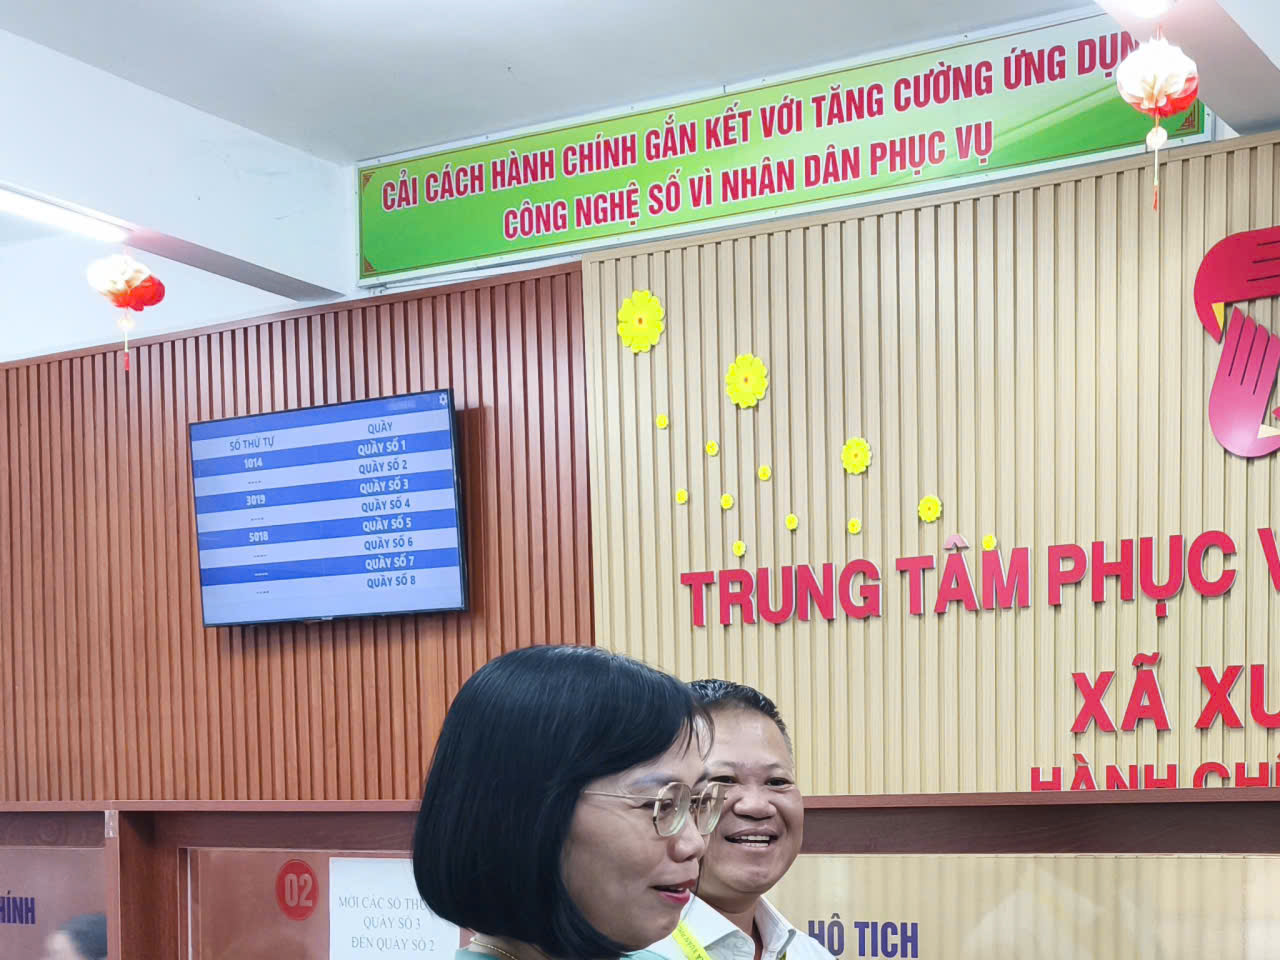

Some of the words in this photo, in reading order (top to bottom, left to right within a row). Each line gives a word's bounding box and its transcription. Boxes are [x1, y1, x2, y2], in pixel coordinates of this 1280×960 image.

[383, 169, 417, 210] CẢI
[426, 164, 483, 201] CÁCH
[492, 151, 553, 190] HÀNH
[563, 134, 636, 176] CHÍNH
[645, 115, 696, 160] GẮN
[706, 102, 752, 150] KẾT
[761, 94, 802, 138] VỚI
[812, 85, 883, 128] TĂNG
[894, 62, 992, 112] CƯỜNG
[1004, 46, 1065, 91] ỨNG
[504, 200, 567, 240] CÔNG
[576, 182, 639, 226] NGHỆ
[649, 168, 681, 215] SỐ
[690, 168, 712, 208] VÌ
[722, 155, 794, 203] NHÂN
[805, 144, 860, 188] DÂN
[871, 131, 945, 175] PHỤC
[956, 121, 993, 165] VỤ
[230, 436, 240, 451] SỐ
[368, 419, 393, 434] QUẦY
[244, 457, 263, 468] 1014
[358, 440, 384, 456] QUẦY
[386, 437, 399, 452] SỐ
[401, 440, 406, 450] 1
[359, 459, 385, 474] QUẦY
[387, 457, 400, 472] SỐ
[402, 460, 408, 470] 2
[360, 479, 386, 494] QUẦY
[388, 476, 401, 491] SỐ
[403, 479, 409, 489] 3
[362, 498, 387, 513] QUẦY
[390, 495, 402, 509] SỐ
[404, 498, 410, 508] 4
[249, 531, 269, 543] 5018
[362, 517, 389, 532] QUẦY
[391, 514, 404, 529] SỐ
[406, 518, 412, 528] 5
[364, 536, 390, 551] QUẦY
[393, 534, 405, 548] SỐ
[408, 537, 413, 547] 6
[365, 555, 392, 570] QUẦY
[394, 552, 407, 567] SỐ
[408, 555, 415, 566] 7
[367, 574, 393, 589] QUẦY
[395, 572, 408, 586] SỐ
[410, 575, 416, 585] 8
[680, 559, 882, 627] TRUNG
[896, 534, 1030, 615] TÂM
[1048, 530, 1237, 617] PHỤC
[1070, 651, 1171, 734] XÃ
[1031, 753, 1178, 791] HÀNH
[285, 873, 312, 907] 02
[415, 918, 421, 929] 3
[429, 940, 435, 951] 2
